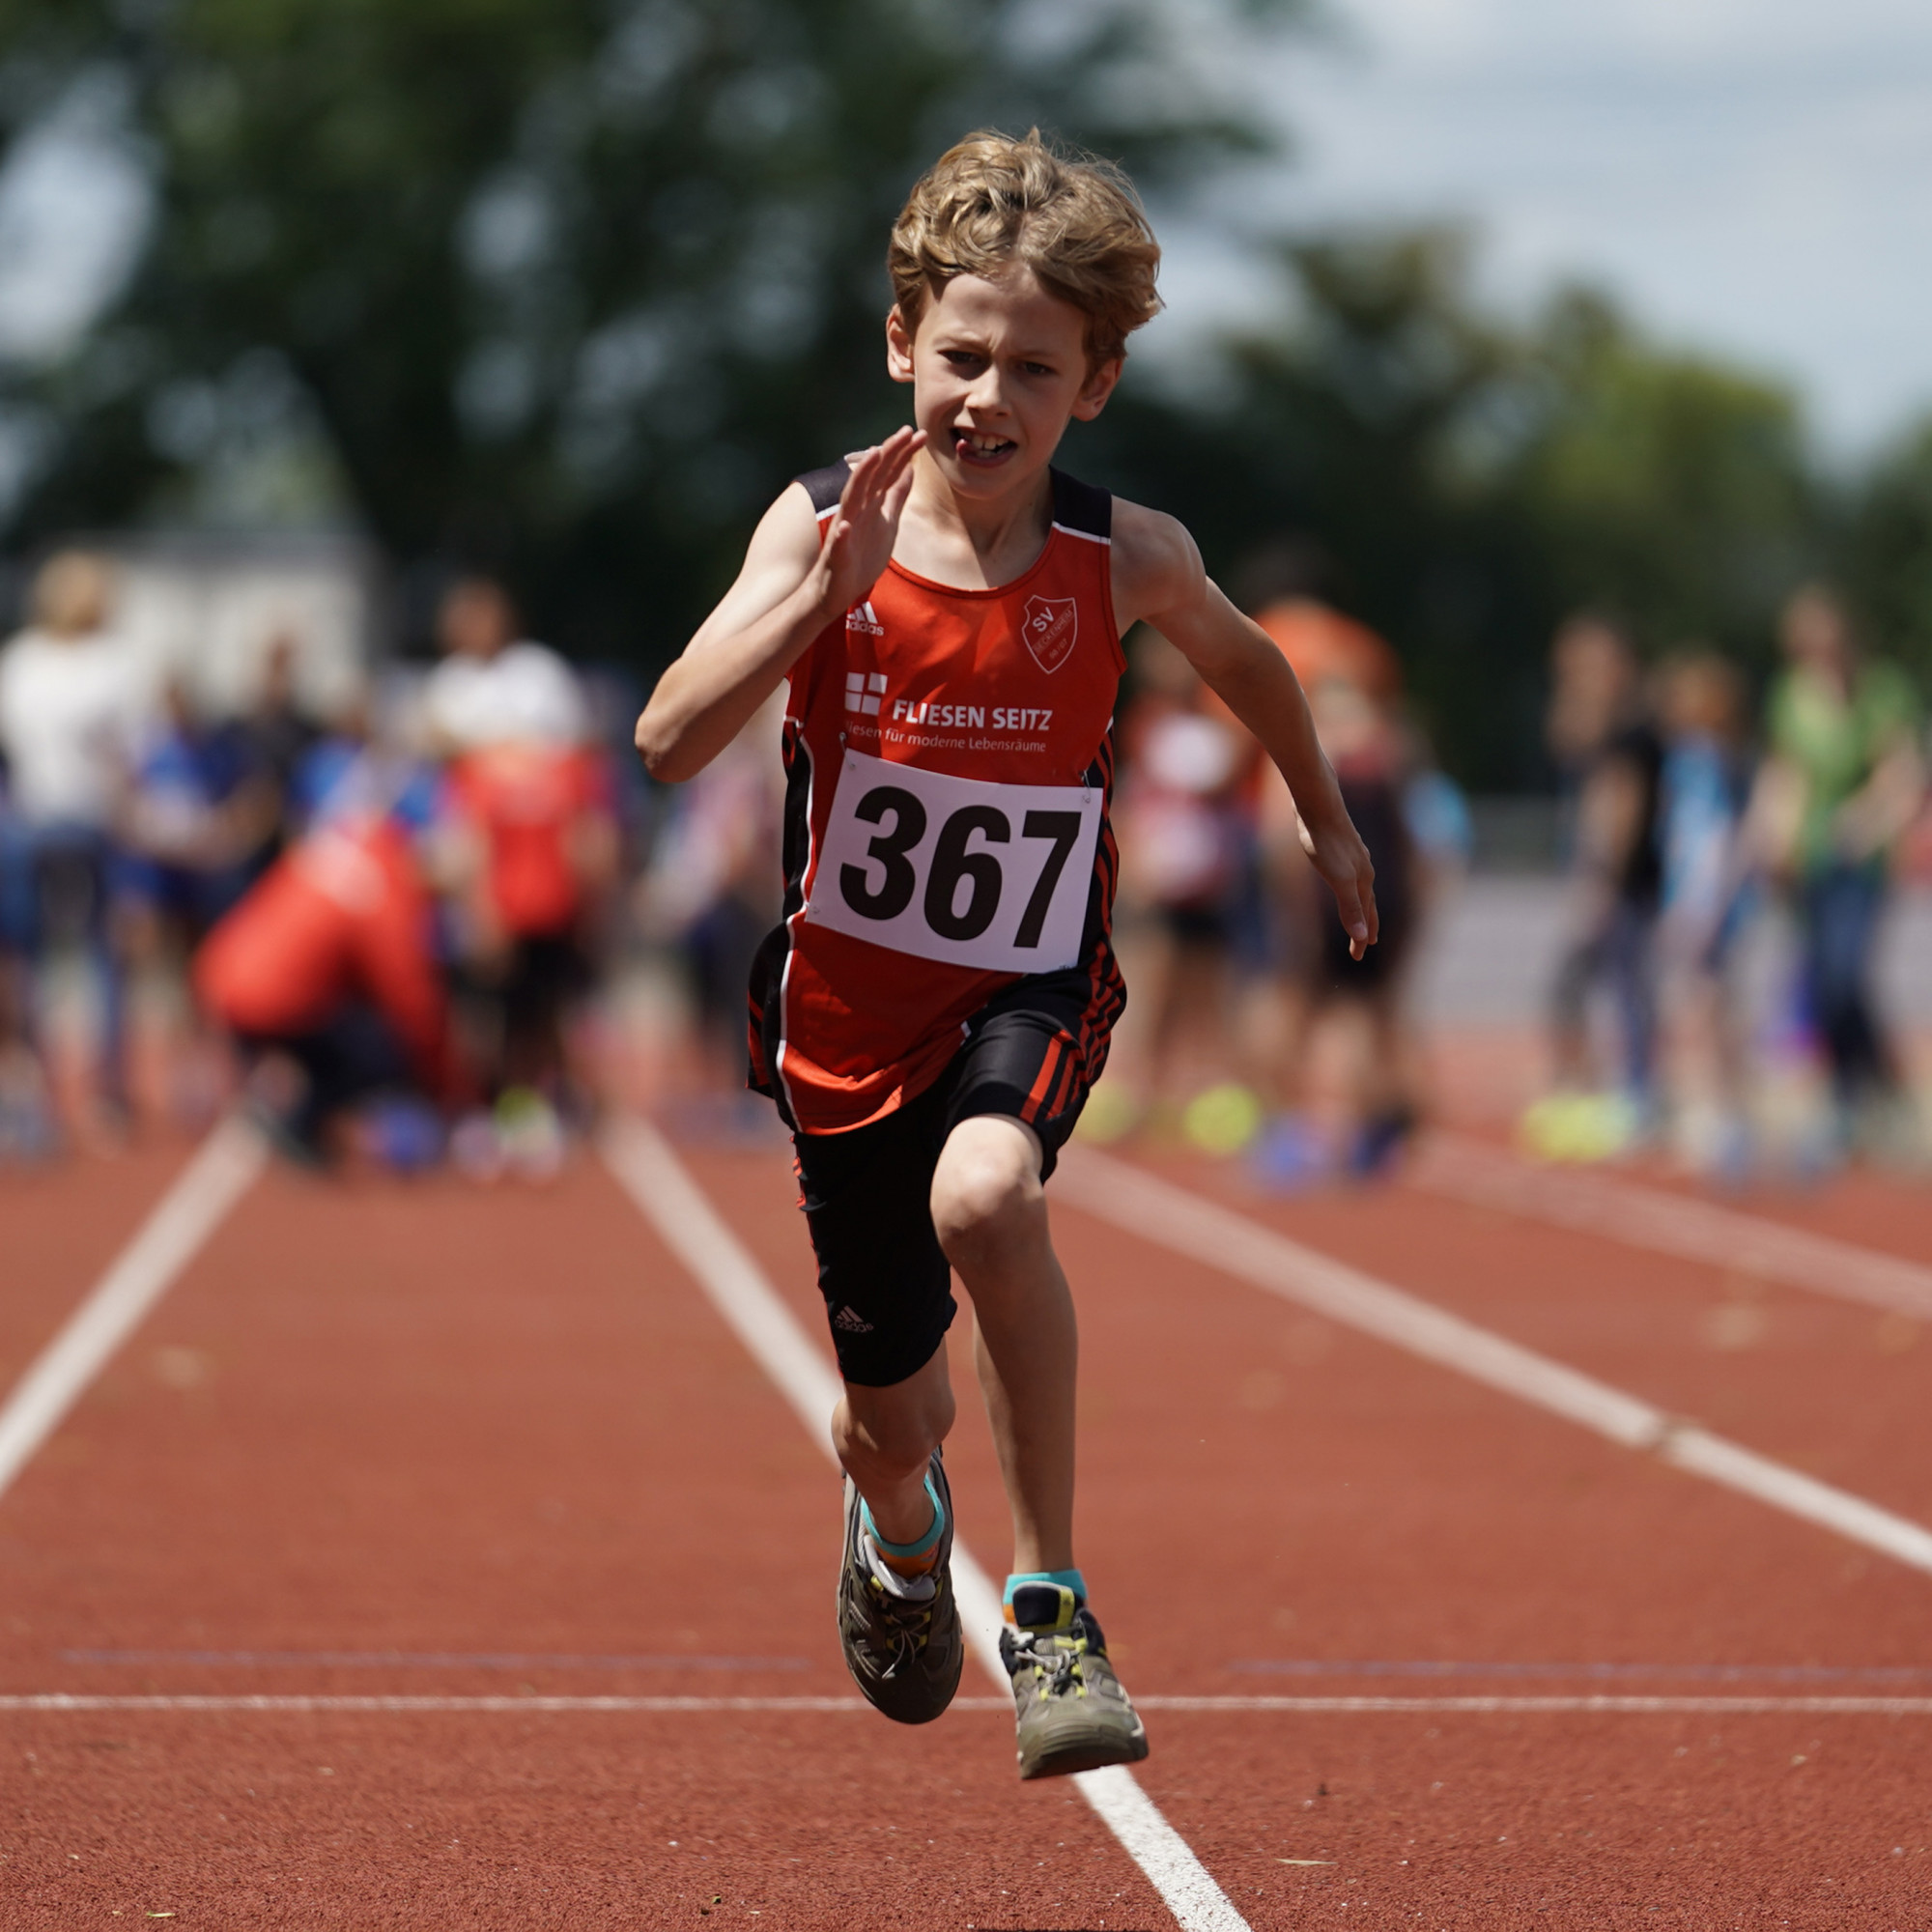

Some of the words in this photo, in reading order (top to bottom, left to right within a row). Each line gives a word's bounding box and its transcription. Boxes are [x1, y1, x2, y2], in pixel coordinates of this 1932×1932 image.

[1033, 606, 1055, 633] SV
[893, 698, 985, 729] FLIESEN
[992, 707, 1053, 731] SEITZ
[885, 726, 905, 743] für
[907, 734, 966, 750] moderne
[969, 736, 1046, 752] Lebensräume
[839, 785, 1083, 949] 367
